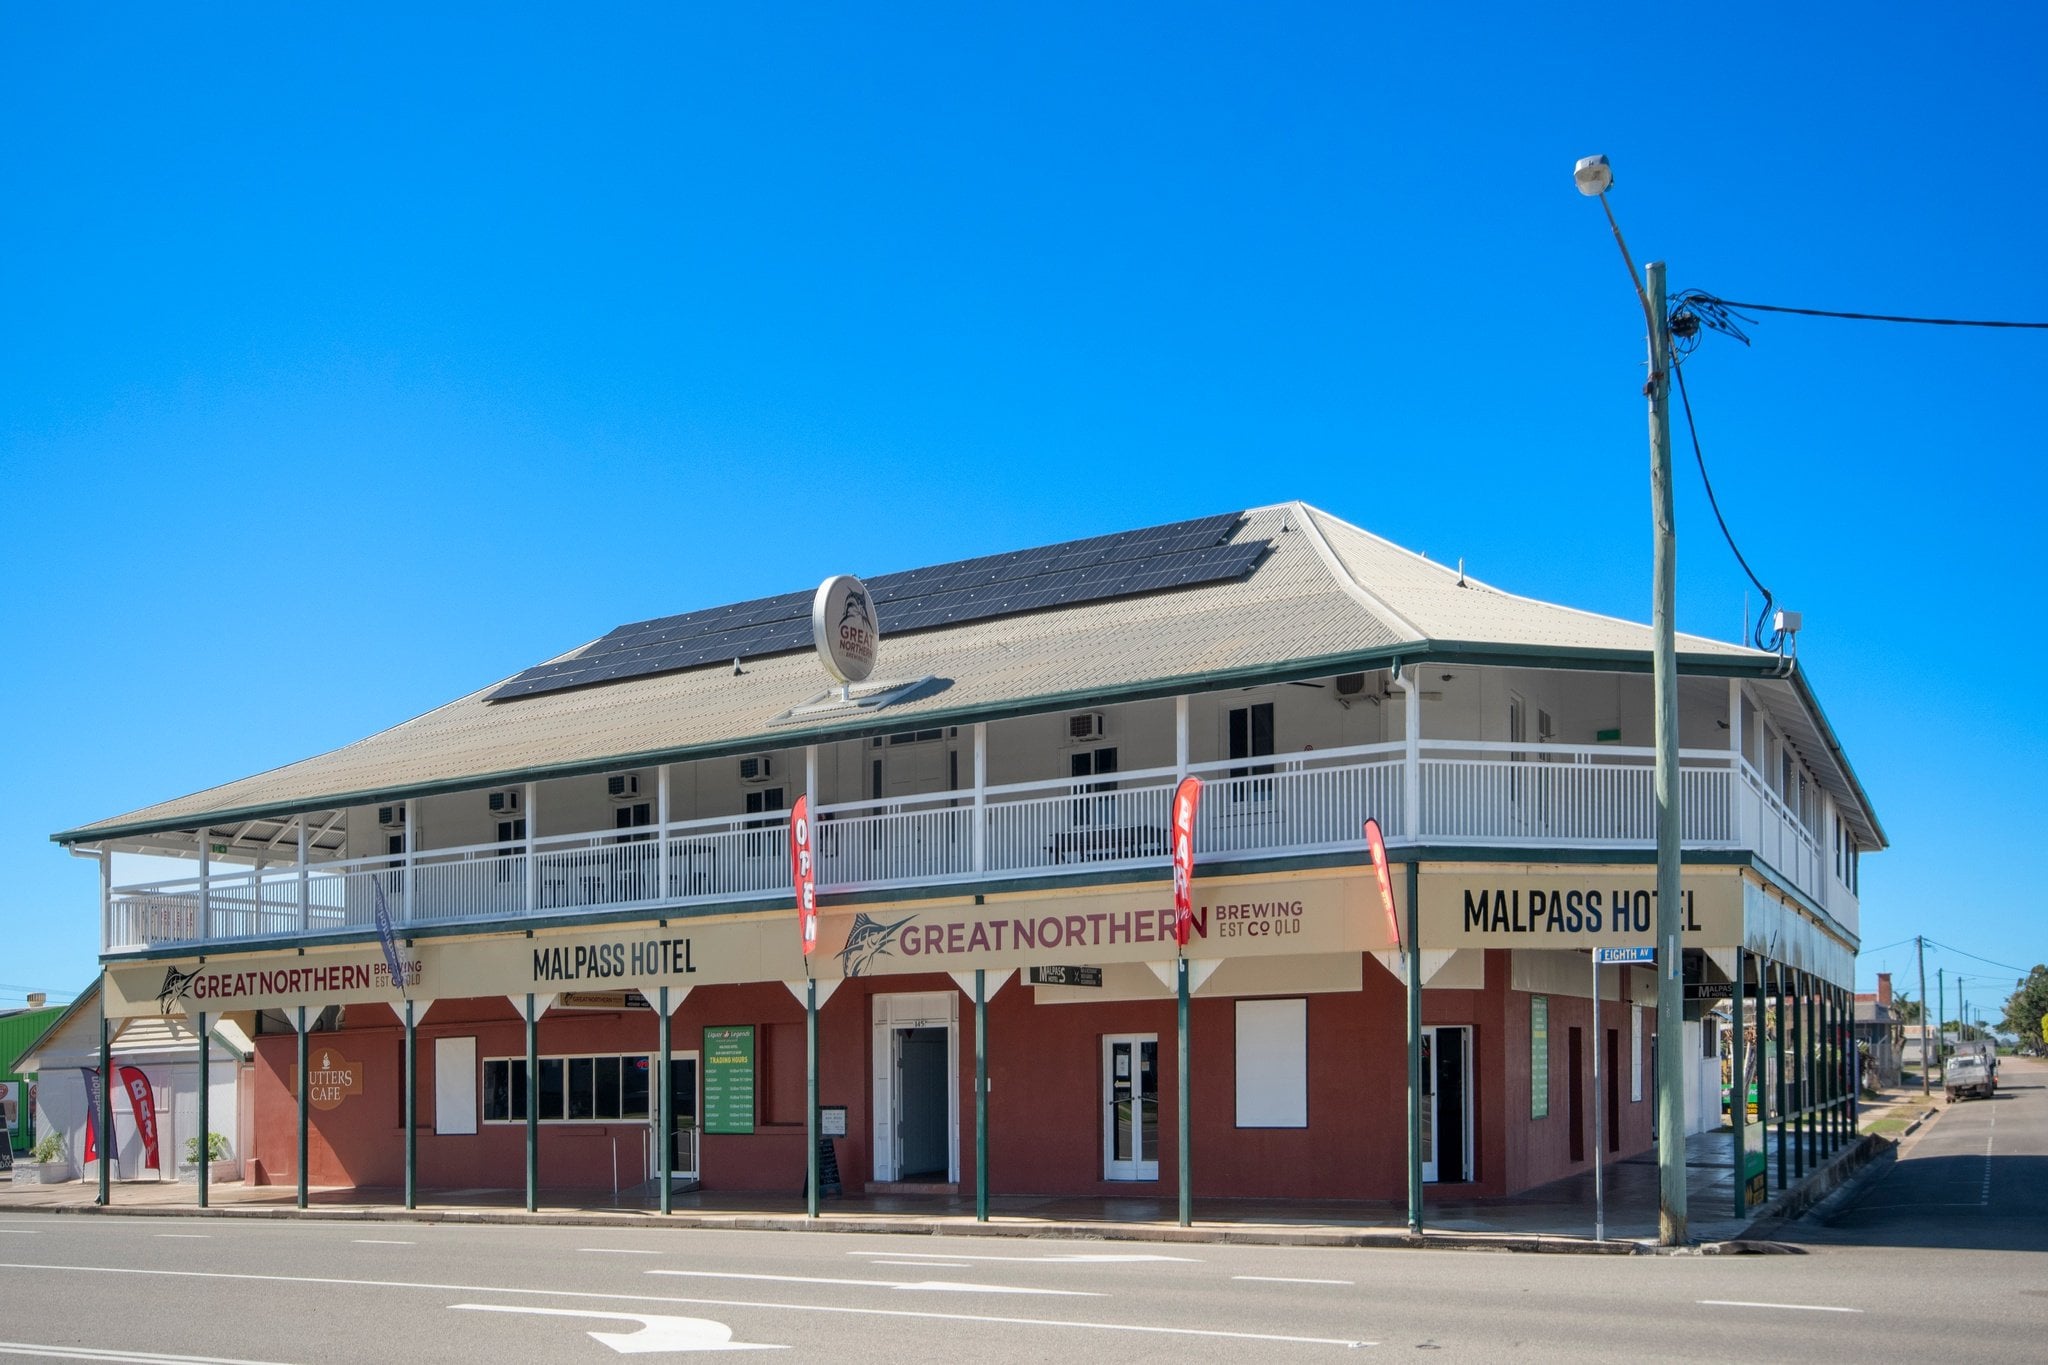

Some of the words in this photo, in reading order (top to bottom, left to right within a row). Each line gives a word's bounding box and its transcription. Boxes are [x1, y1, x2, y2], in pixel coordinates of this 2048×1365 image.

[841, 625, 873, 648] GREAT
[840, 640, 873, 659] NORTHERN
[796, 818, 817, 941] OPEN
[1216, 901, 1303, 920] BREWING
[1464, 889, 1602, 932] MALPASS
[1613, 889, 1702, 932] HOL
[1220, 922, 1244, 937] EST
[1275, 919, 1300, 936] QLD
[534, 943, 625, 981] MALPASS
[631, 938, 696, 976] HOTEL
[1604, 948, 1637, 960] EIGHTH
[1640, 948, 1649, 957] AV
[376, 976, 389, 987] EST
[1699, 985, 1732, 998] MALPAS
[309, 1070, 352, 1087] UTTERS
[311, 1086, 341, 1101] CAFE
